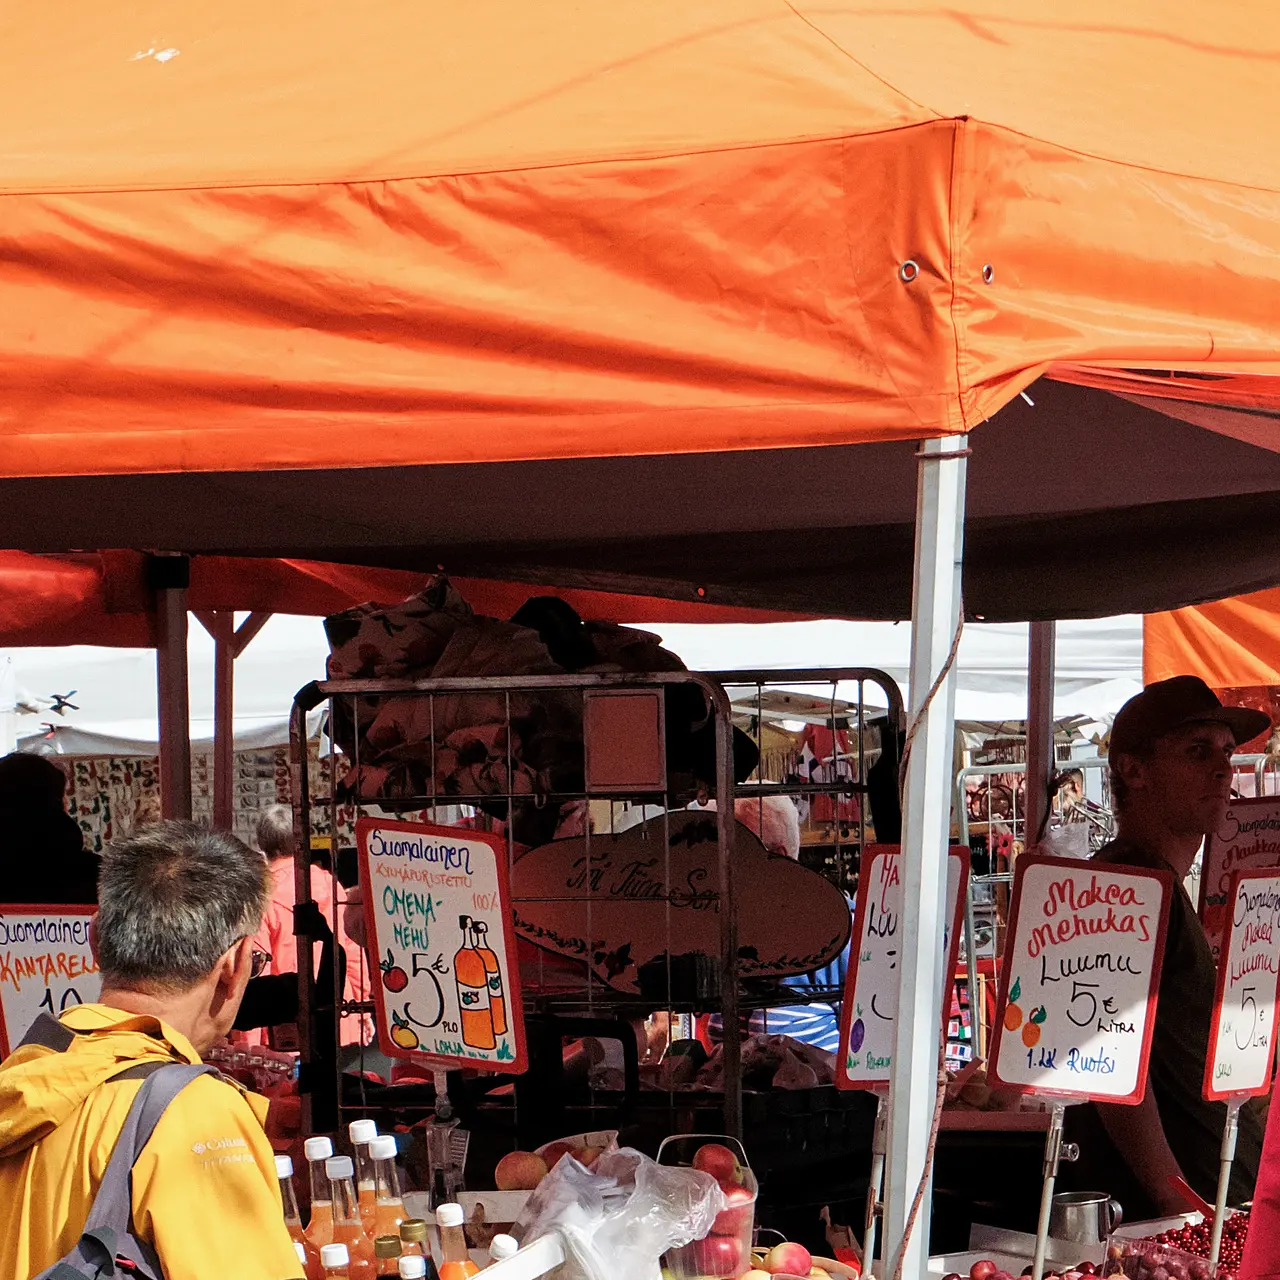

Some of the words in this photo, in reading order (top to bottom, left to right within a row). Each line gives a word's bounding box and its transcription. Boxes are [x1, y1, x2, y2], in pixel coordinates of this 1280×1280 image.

[370, 829, 473, 875] Suomalainen
[1042, 875, 1145, 918] Makea
[393, 922, 430, 951] MEHU
[1066, 1046, 1118, 1075] Ruotsi
